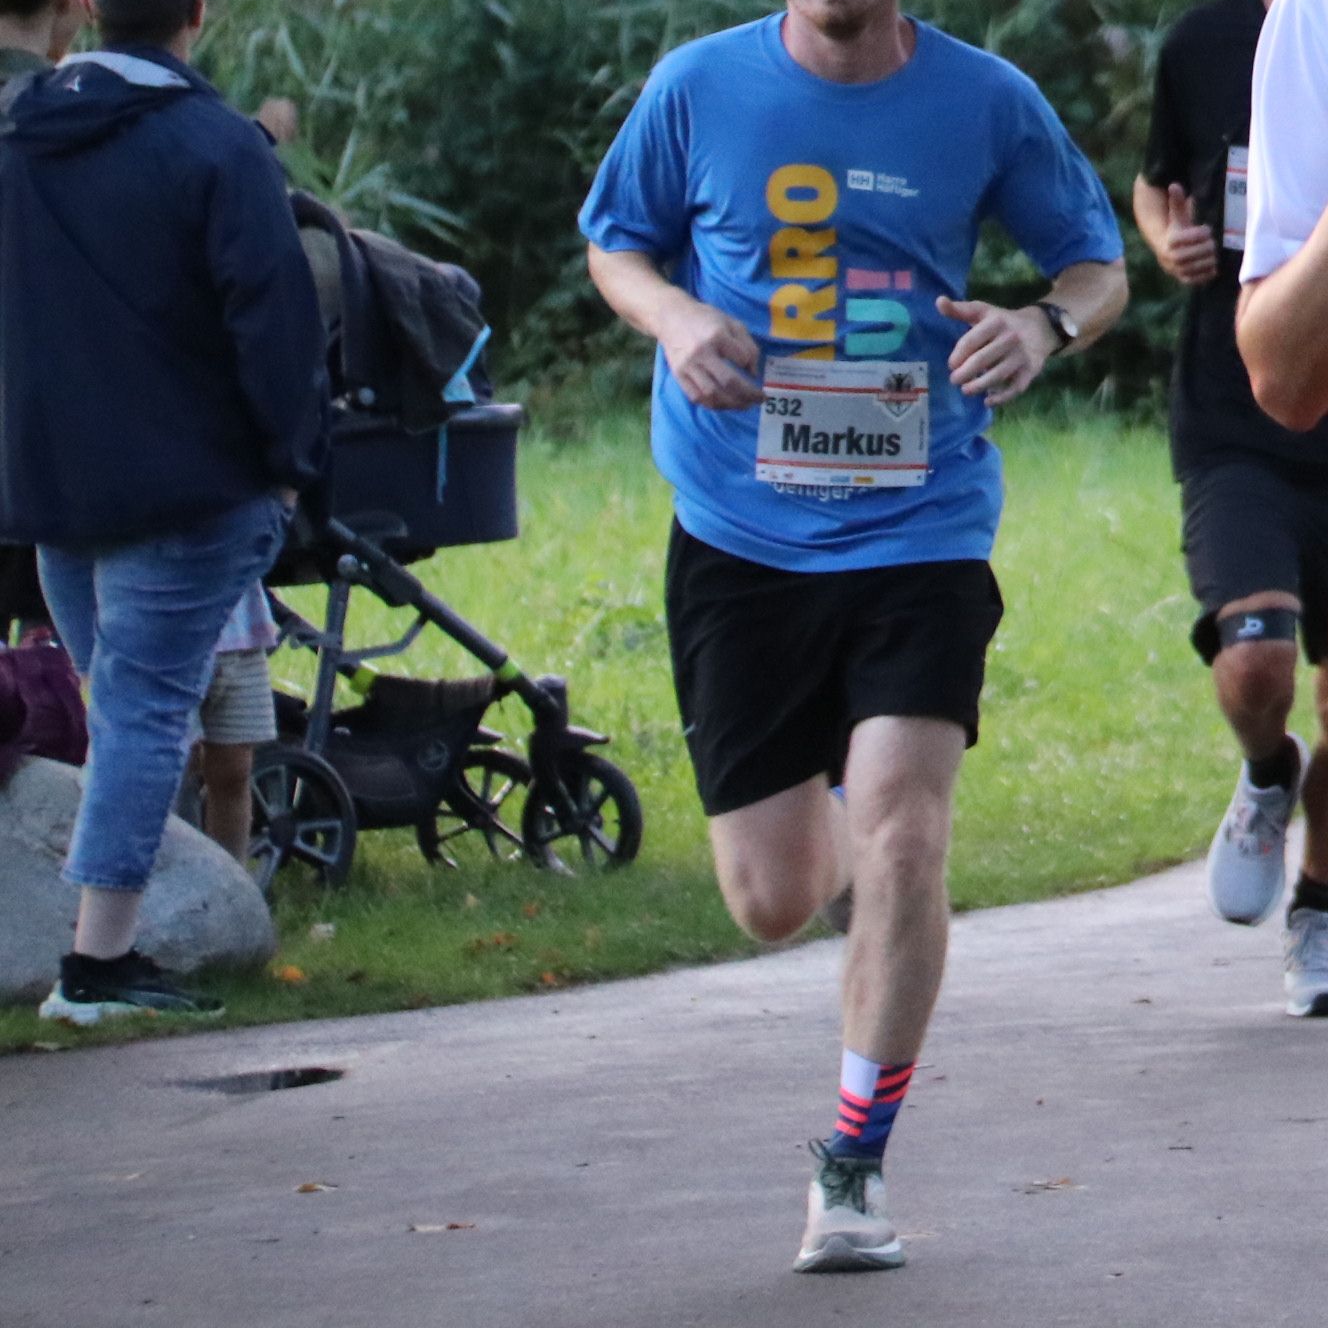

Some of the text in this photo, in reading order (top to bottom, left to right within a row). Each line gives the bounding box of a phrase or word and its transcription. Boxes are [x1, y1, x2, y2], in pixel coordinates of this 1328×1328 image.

[765, 162, 839, 362] RRO
[765, 396, 803, 417] 532
[782, 422, 902, 457] Markus
